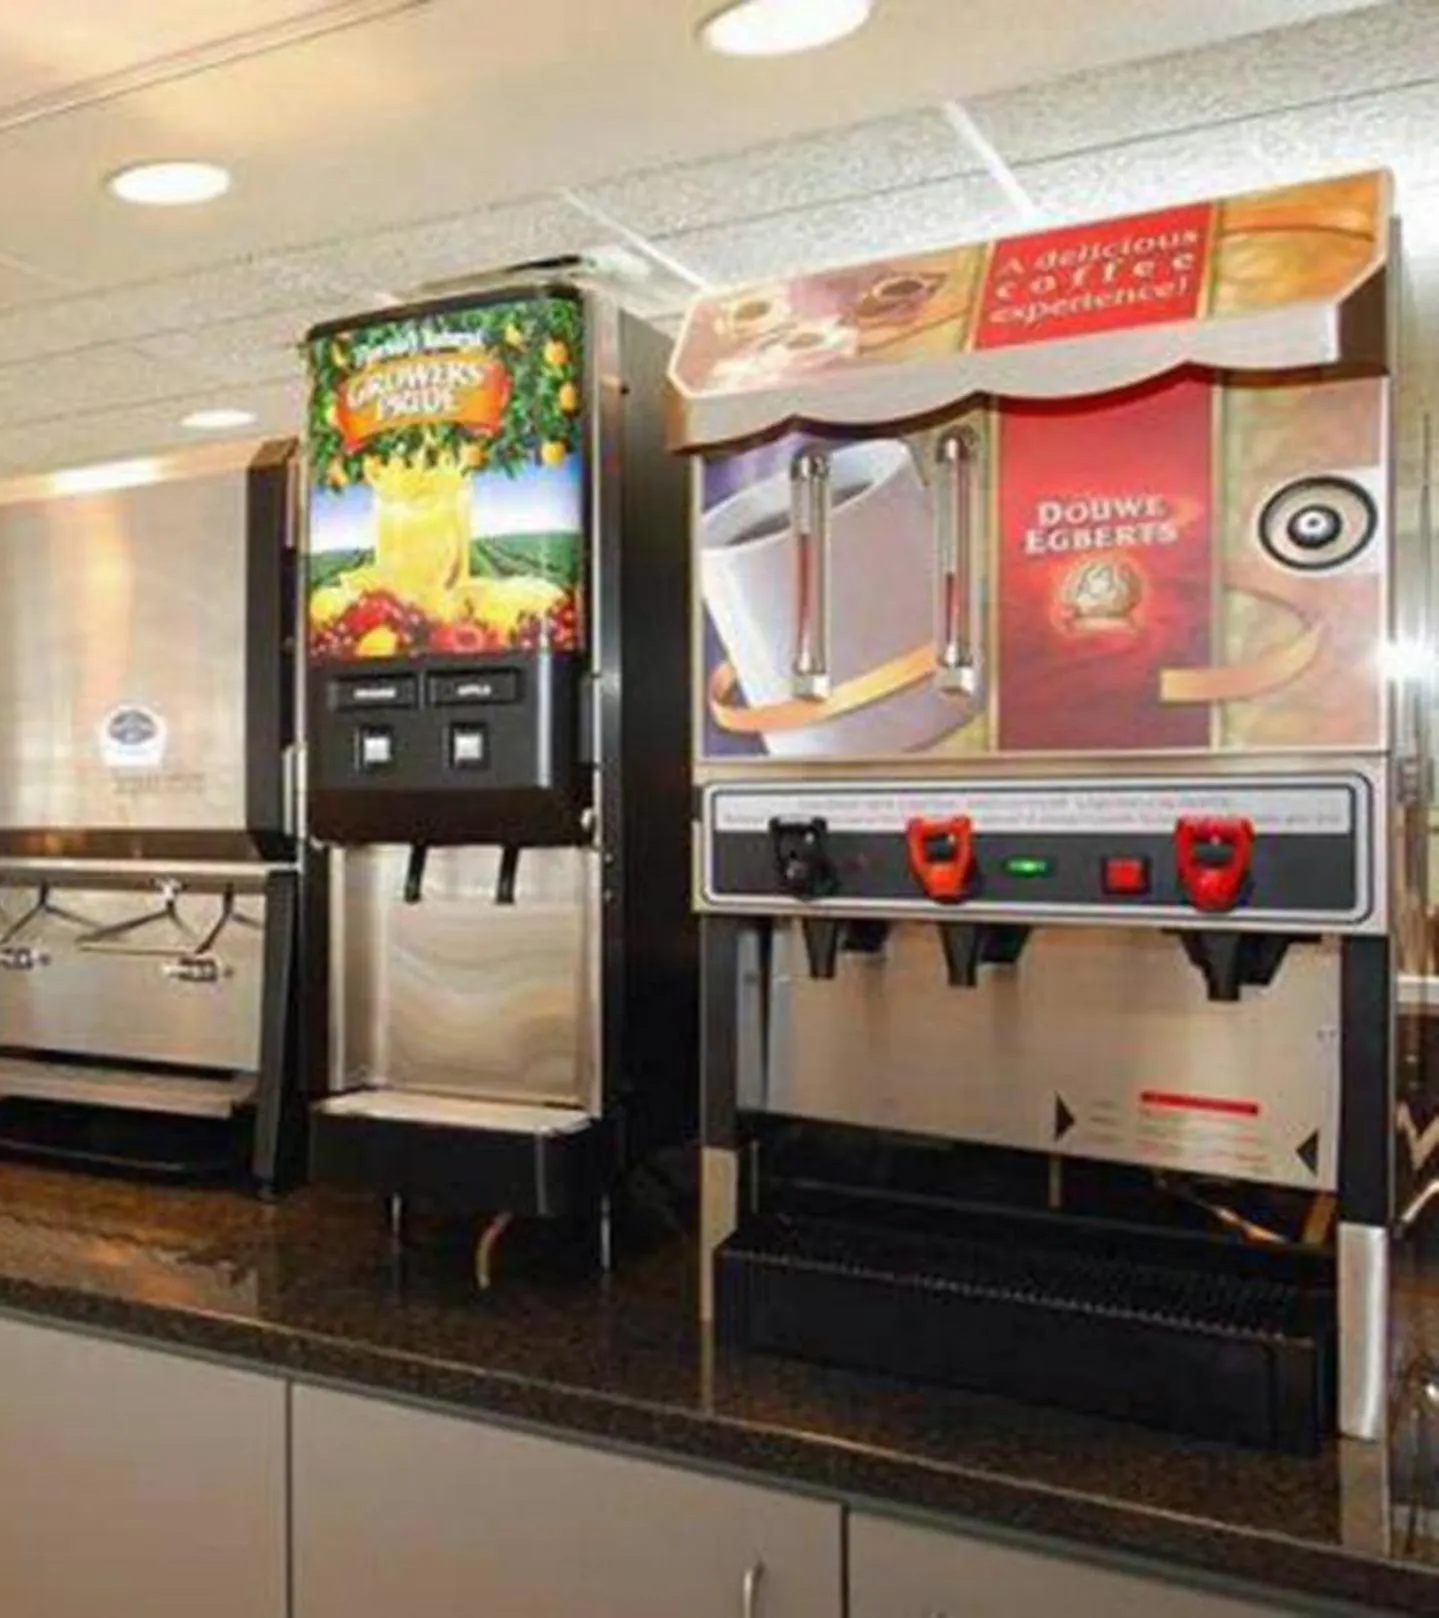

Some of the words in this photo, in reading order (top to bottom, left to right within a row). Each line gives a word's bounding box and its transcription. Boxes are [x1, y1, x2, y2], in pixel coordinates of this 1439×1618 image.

[1034, 228, 1199, 271] delicious
[995, 251, 1195, 300] coffee
[989, 275, 1188, 325] experience!
[1036, 494, 1167, 527] DOUWE
[1024, 520, 1178, 556] EGBERTS
